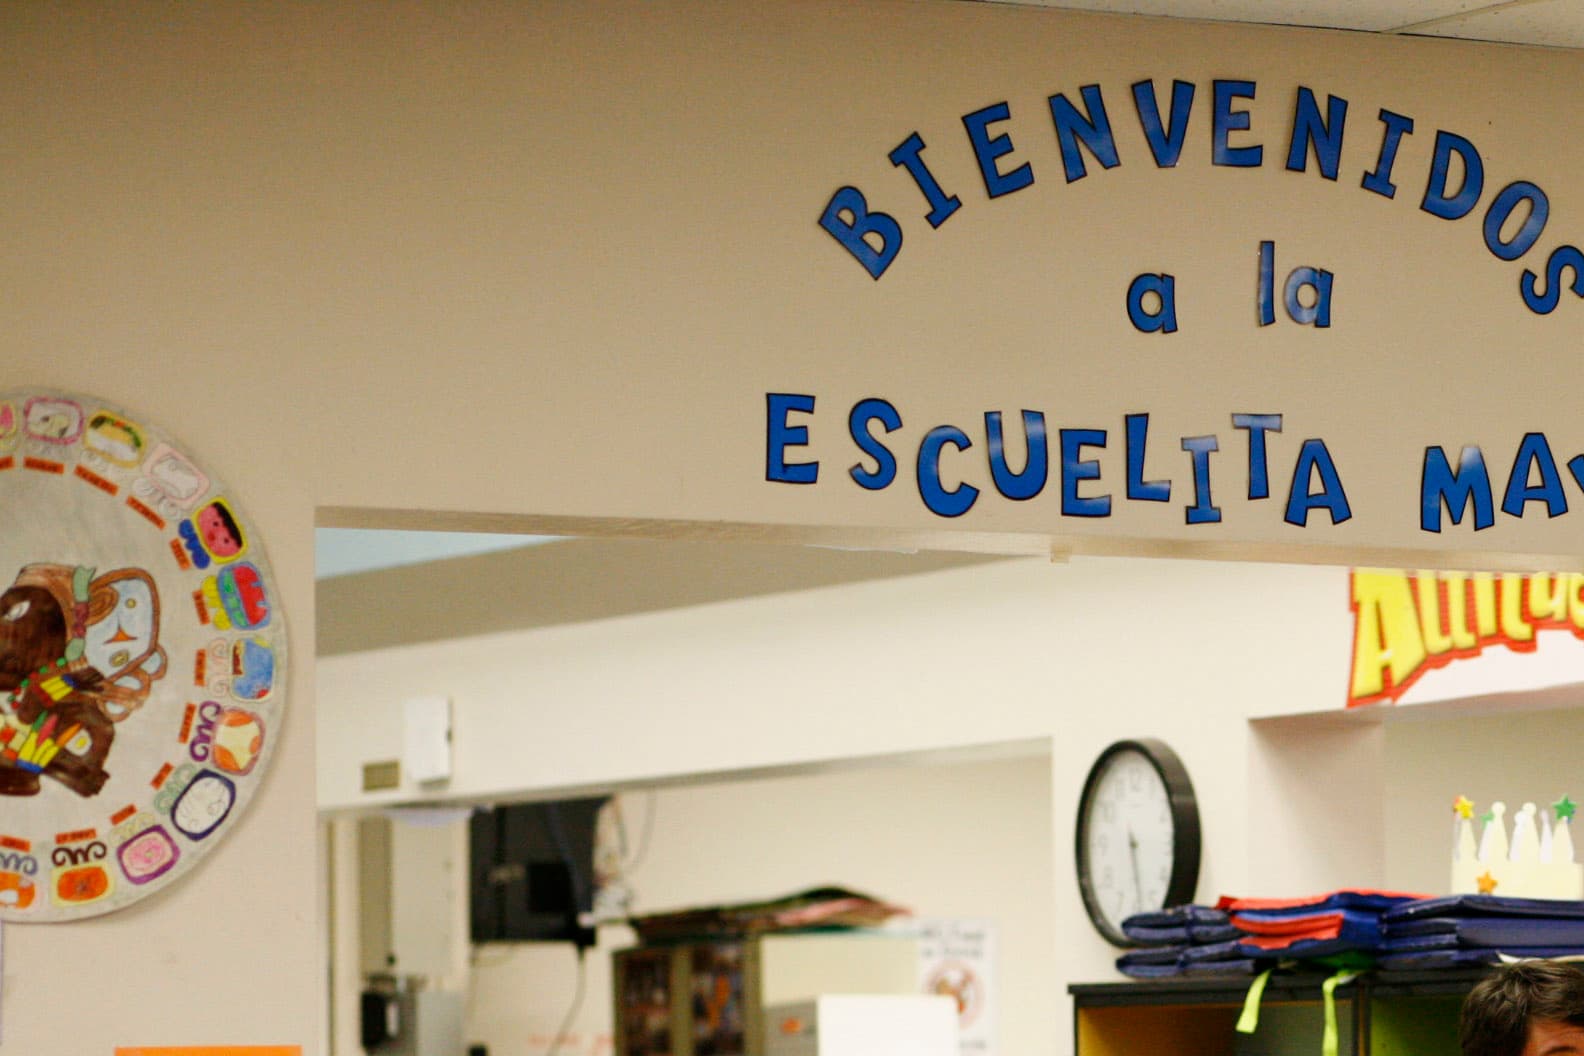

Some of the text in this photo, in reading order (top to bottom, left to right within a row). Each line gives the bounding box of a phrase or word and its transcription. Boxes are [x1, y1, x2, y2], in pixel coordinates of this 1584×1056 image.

[1126, 241, 1334, 334] a la
[765, 393, 1352, 527] ESCUELITA
